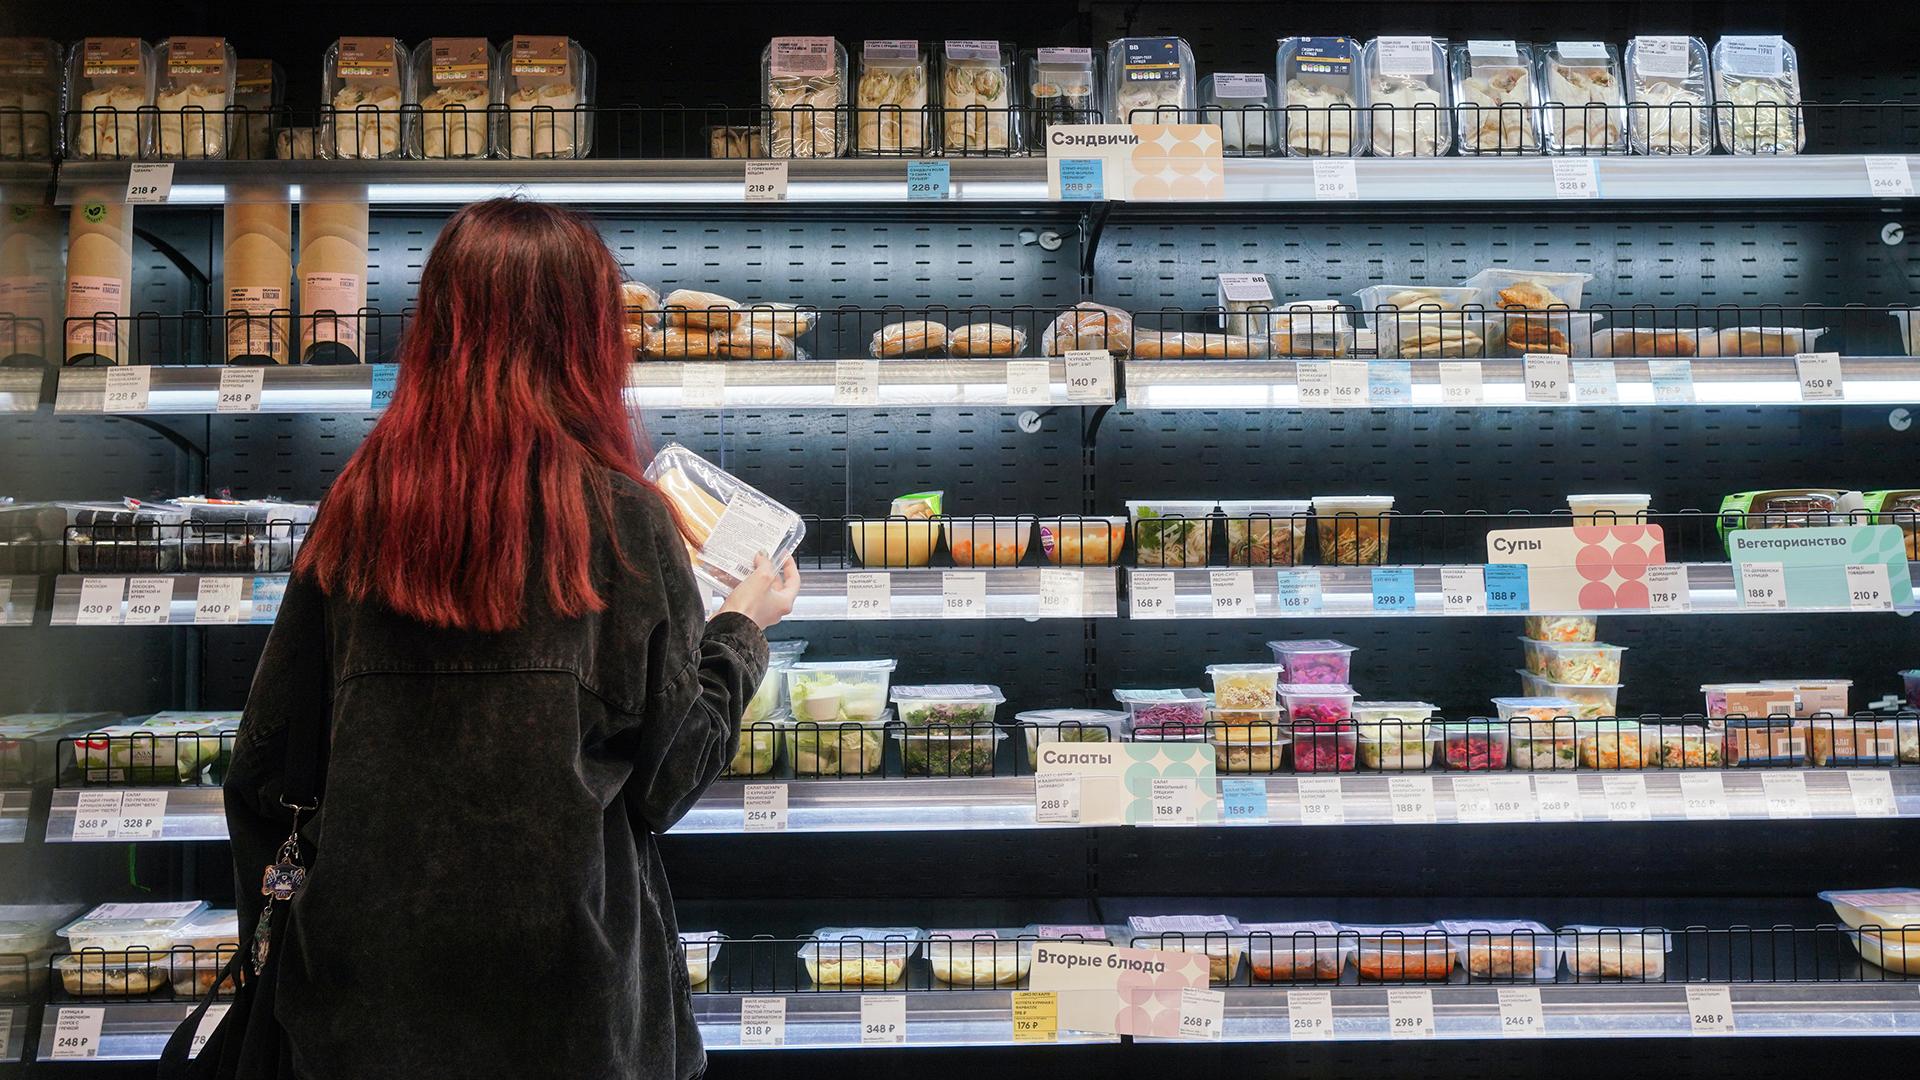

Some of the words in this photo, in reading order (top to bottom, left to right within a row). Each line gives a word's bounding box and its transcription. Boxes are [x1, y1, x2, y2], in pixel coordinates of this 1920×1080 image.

[1052, 132, 1139, 147] Сэндвичи
[912, 183, 931, 192] 228
[932, 183, 940, 191] ₽
[1319, 183, 1336, 192] 218
[1337, 183, 1344, 191] ₽
[1559, 181, 1578, 190] 328
[1580, 182, 1587, 190] ₽
[1874, 179, 1894, 187] 246
[1895, 178, 1902, 187] ₽
[131, 186, 148, 195] 218
[150, 186, 158, 194] ₽
[748, 184, 765, 193] 218
[767, 184, 775, 192] ₽
[1071, 377, 1089, 387] 140
[1091, 377, 1098, 386] ₽
[1530, 380, 1547, 389] 194
[1549, 380, 1556, 389] ₽
[1805, 379, 1825, 388] 450
[1826, 379, 1833, 388] ₽
[108, 392, 128, 401] 228
[130, 391, 138, 401] ₽
[1302, 388, 1321, 397] 263
[1323, 388, 1330, 396] ₽
[1335, 386, 1352, 396] 165
[1354, 387, 1361, 395] ₽
[1372, 386, 1392, 396] 228
[222, 393, 242, 403] 248
[244, 393, 252, 402] ₽
[1494, 539, 1541, 554] Супы
[1737, 537, 1847, 551] Вегетарианство
[1491, 591, 1508, 601] 188
[1509, 591, 1517, 600] ₽
[1652, 592, 1669, 602] 178
[1671, 592, 1677, 601] ₽
[1748, 588, 1765, 598] 188
[1767, 589, 1774, 598] ₽
[1853, 591, 1870, 600] 210
[1872, 591, 1879, 600] ₽
[851, 599, 870, 609] 278
[872, 599, 879, 609] ₽
[946, 599, 964, 608] 158
[965, 599, 973, 608] ₽
[1137, 598, 1153, 608] 168
[1155, 598, 1162, 607] ₽
[1216, 598, 1233, 607] 198
[1235, 597, 1242, 606] ₽
[1283, 597, 1301, 607] 168
[1303, 597, 1309, 605] ₽
[1377, 595, 1396, 605] 298
[1398, 595, 1405, 604] ₽
[1447, 595, 1464, 604] 168
[1466, 595, 1473, 604] ₽
[82, 604, 104, 614] 430
[105, 605, 113, 614] ₽
[130, 605, 151, 614] 450
[153, 605, 161, 614] ₽
[200, 604, 221, 614] 440
[223, 604, 231, 613] ₽
[1043, 751, 1112, 765] Салаты
[1041, 799, 1060, 810] 288
[1063, 799, 1069, 808] ₽
[1304, 804, 1321, 814] 138
[1323, 804, 1330, 814] ₽
[1396, 803, 1413, 813] 188
[1415, 803, 1422, 812] ₽
[1494, 801, 1512, 812] 168
[1513, 802, 1520, 810] ₽
[1542, 801, 1561, 810] 268
[1563, 801, 1570, 810] ₽
[1610, 801, 1628, 810] 160
[1156, 806, 1173, 815] 158
[1175, 806, 1182, 815] ₽
[1228, 806, 1246, 815] 158
[1247, 805, 1255, 814] ₽
[748, 811, 767, 820] 254
[770, 811, 777, 820] ₽
[78, 819, 98, 829] 368
[100, 819, 108, 828] ₽
[123, 818, 143, 828] 328
[145, 818, 153, 828] ₽
[1037, 949, 1103, 969] Вторые
[1107, 954, 1165, 974] блюда
[1183, 1016, 1202, 1027] 268
[1204, 1018, 1212, 1028] ₽
[1294, 1019, 1313, 1028] 258
[1315, 1018, 1322, 1027] ₽
[1395, 1017, 1414, 1027] 298
[1416, 1017, 1423, 1026] ₽
[1505, 1016, 1525, 1026] 246
[1527, 1016, 1534, 1025] ₽
[1695, 1014, 1715, 1024] 248
[1717, 1014, 1724, 1023] ₽
[866, 1024, 886, 1034] 348
[888, 1024, 896, 1033] ₽
[1017, 1021, 1031, 1030] 176
[1032, 1021, 1039, 1029] ₽
[745, 1026, 762, 1036] 318
[764, 1026, 772, 1035] ₽
[58, 1037, 79, 1047] 248
[81, 1037, 88, 1047] ₽
[194, 1035, 206, 1045] 78
